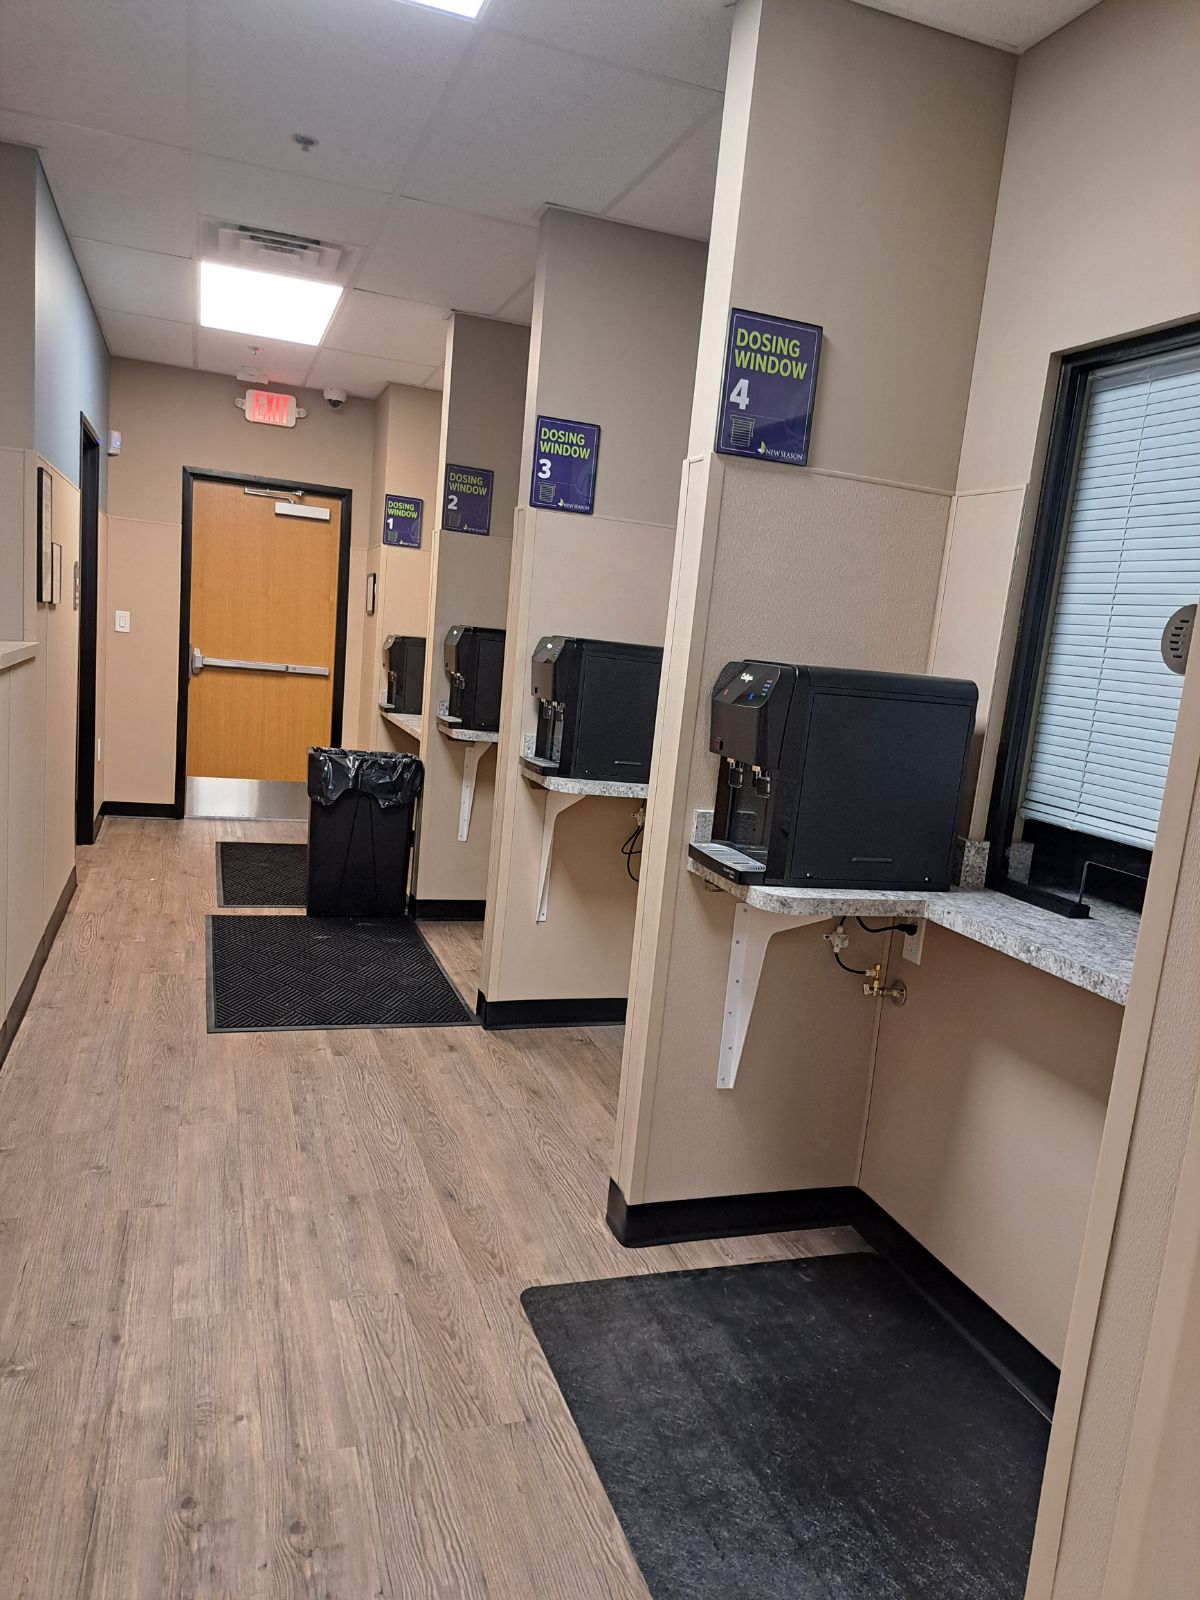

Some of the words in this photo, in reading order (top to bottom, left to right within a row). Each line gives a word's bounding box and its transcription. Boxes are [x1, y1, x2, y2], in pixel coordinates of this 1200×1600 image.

[736, 328, 800, 357] DOSING
[735, 349, 807, 380] WINDOW
[729, 378, 750, 410] 4
[254, 392, 289, 423] EXIT
[541, 428, 585, 445] DOSING
[540, 441, 590, 459] WINDOW
[537, 458, 552, 479] 3
[449, 473, 483, 485] DOSING
[448, 482, 487, 495] WINDOW
[388, 501, 414, 510] DOSING
[448, 495, 458, 510] 2
[387, 508, 417, 518] WINDOW
[387, 518, 393, 529] 1
